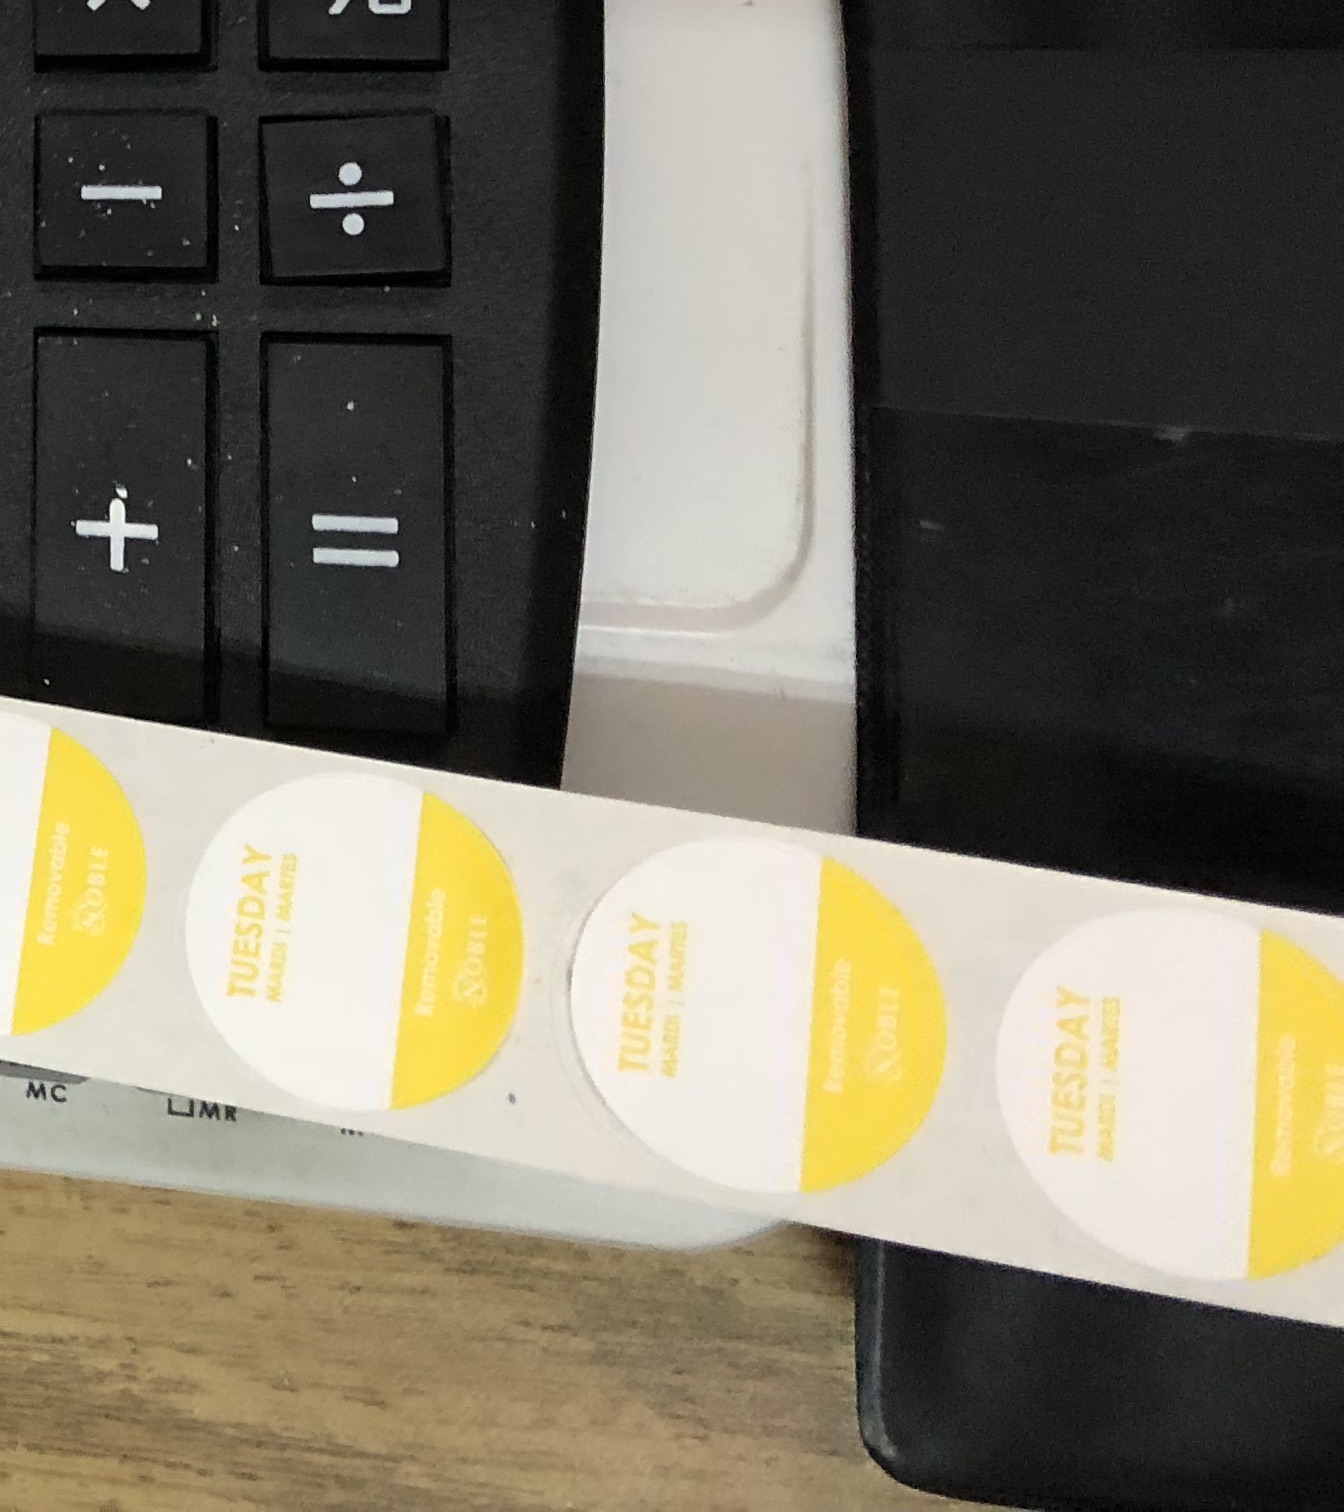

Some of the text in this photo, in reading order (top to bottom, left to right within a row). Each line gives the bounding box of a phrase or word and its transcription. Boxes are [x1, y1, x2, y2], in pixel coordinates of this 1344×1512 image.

[36, 820, 70, 948] Removable
[74, 842, 110, 938] NOBLE
[225, 842, 275, 998] TUESDAY
[265, 852, 300, 1003] MARDI MARTES
[415, 887, 449, 1018] Removable
[453, 911, 490, 1009] NOBLE
[617, 912, 662, 1074] TUESDAY
[25, 1080, 69, 1104] MC
[661, 1011, 681, 1078] MARDI
[823, 956, 853, 1095] Removable
[1048, 985, 1091, 1156] TUESDAY
[1269, 1033, 1296, 1176] Removable
